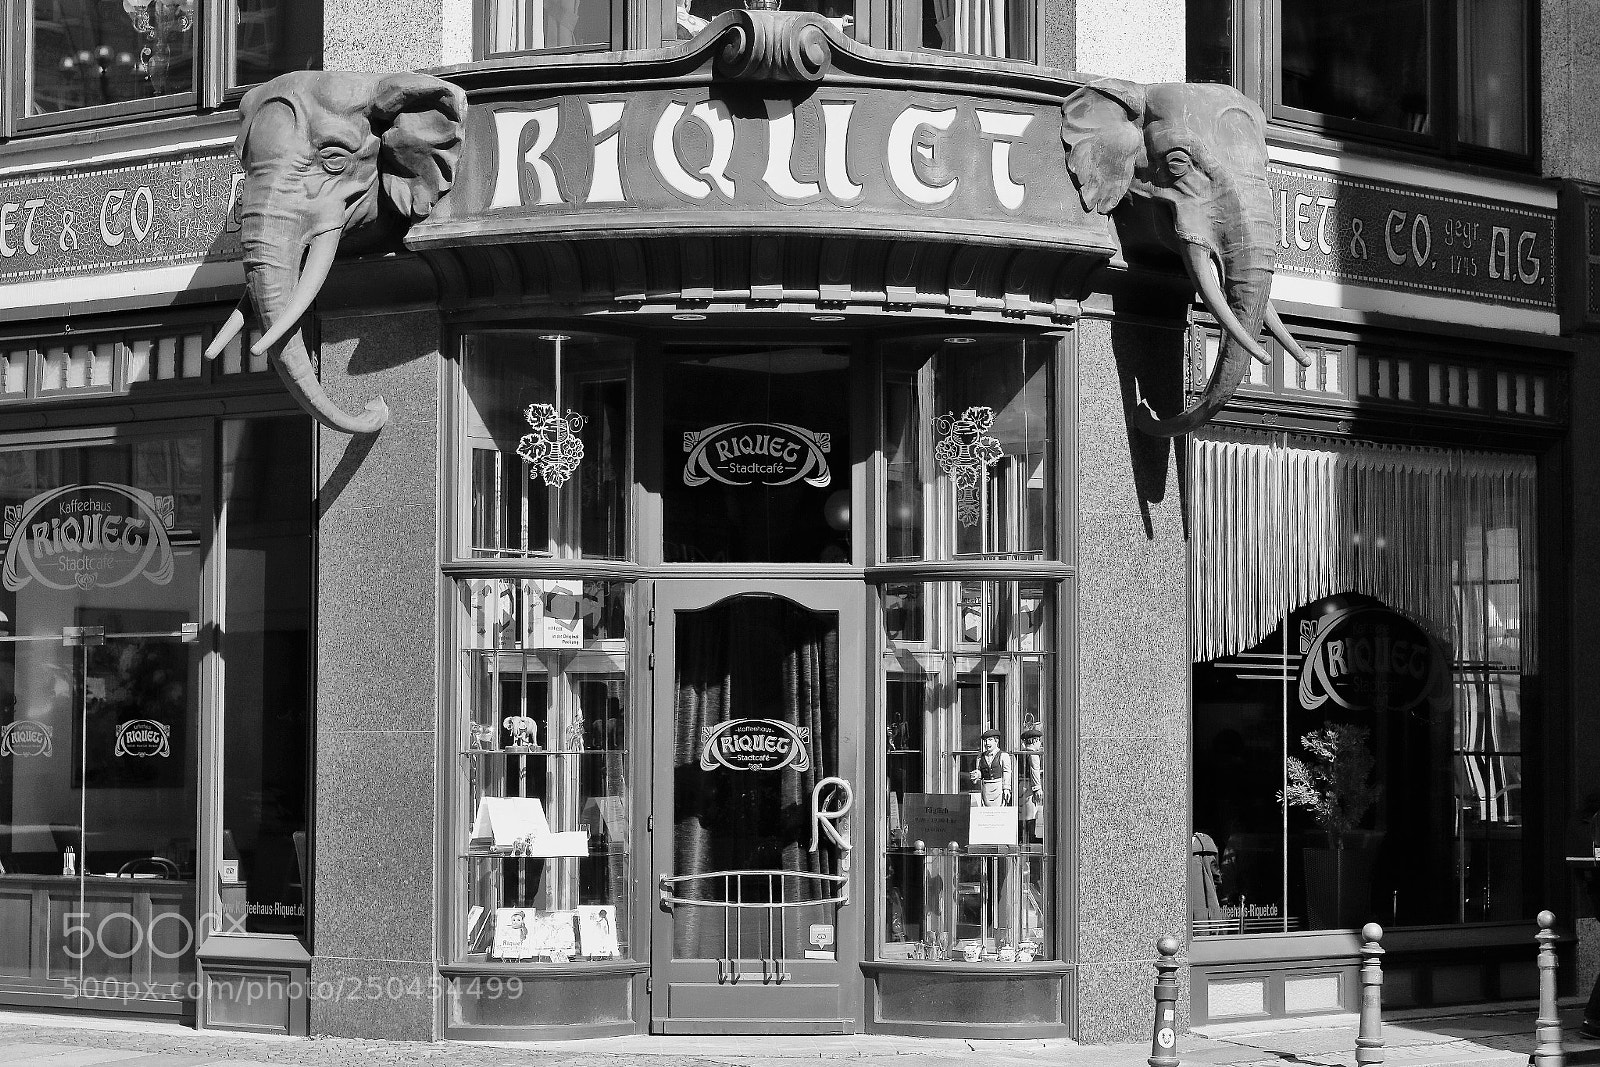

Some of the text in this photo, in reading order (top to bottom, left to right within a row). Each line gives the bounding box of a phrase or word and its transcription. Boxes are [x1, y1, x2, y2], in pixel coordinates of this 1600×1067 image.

[490, 99, 1035, 210] RIQUET
[59, 210, 79, 252] &
[1350, 218, 1368, 260] &
[1444, 218, 1482, 249] gegr.
[1451, 255, 1478, 277] 1745
[715, 434, 802, 463] RIQUET
[729, 462, 784, 474] Stadtcafé
[59, 498, 112, 515] Kaffeehaus
[32, 513, 146, 559] RIQUET
[58, 554, 115, 572] Stadtcafé
[11, 731, 44, 744] RIQUET
[126, 730, 160, 744] RIQUET
[720, 734, 791, 754] RIQUET
